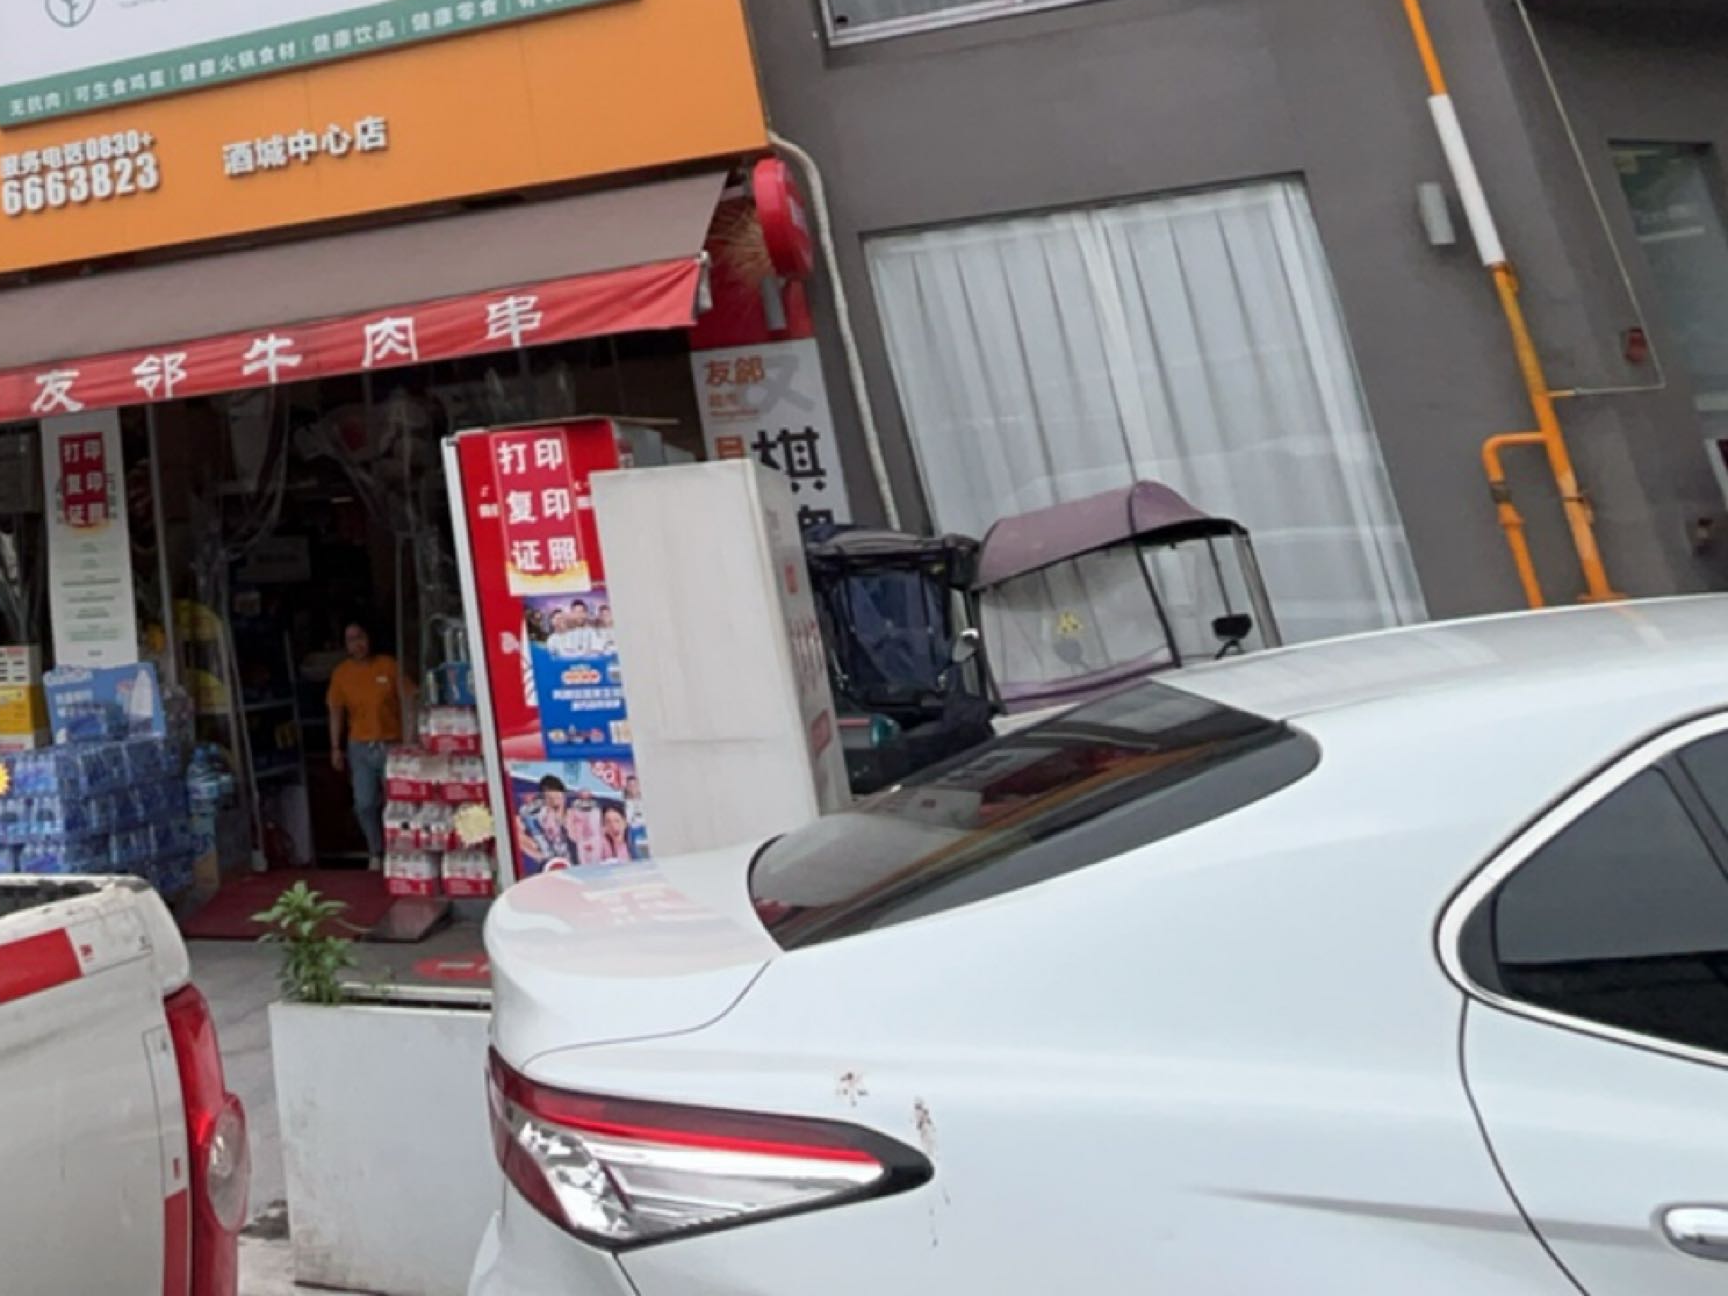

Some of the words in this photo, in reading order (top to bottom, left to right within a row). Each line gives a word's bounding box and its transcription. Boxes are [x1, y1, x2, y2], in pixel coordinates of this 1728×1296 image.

[222, 115, 390, 179] 酒城中心店
[1, 152, 161, 217] 6663823
[31, 295, 544, 413] 友邻牛肉串
[497, 438, 564, 475] 打印
[506, 487, 571, 525] 复印
[511, 536, 579, 572] 证照
